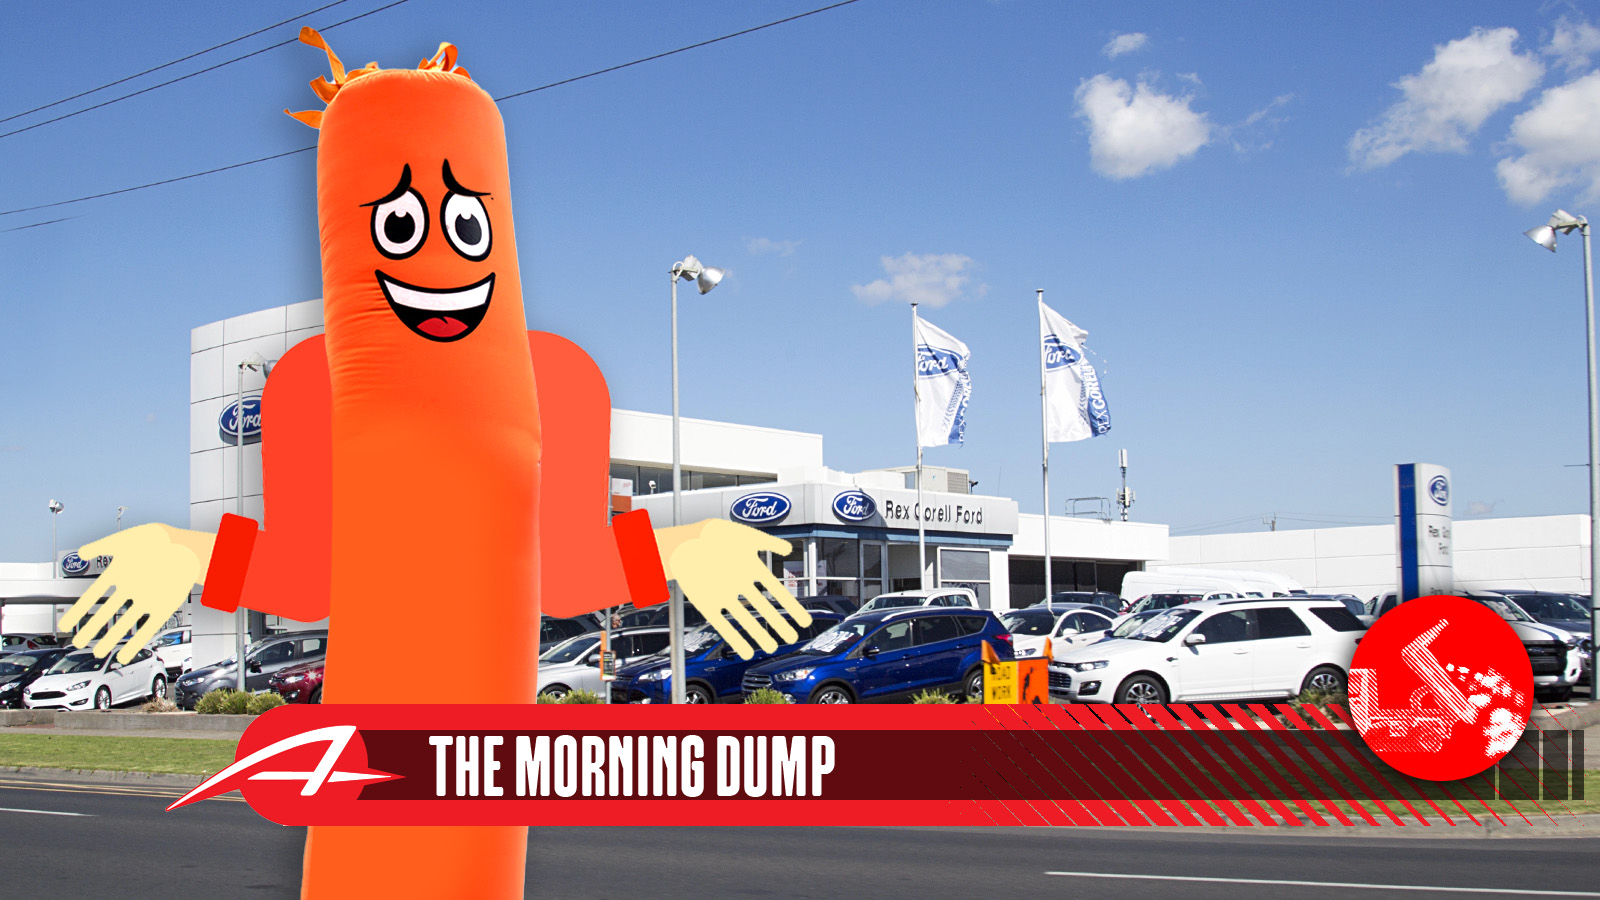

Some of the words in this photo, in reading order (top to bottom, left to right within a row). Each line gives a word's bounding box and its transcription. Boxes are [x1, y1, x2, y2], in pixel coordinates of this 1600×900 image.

[741, 497, 778, 518] Ford
[841, 495, 870, 516] Ford
[885, 500, 910, 520] Rex
[955, 505, 983, 525] Ford
